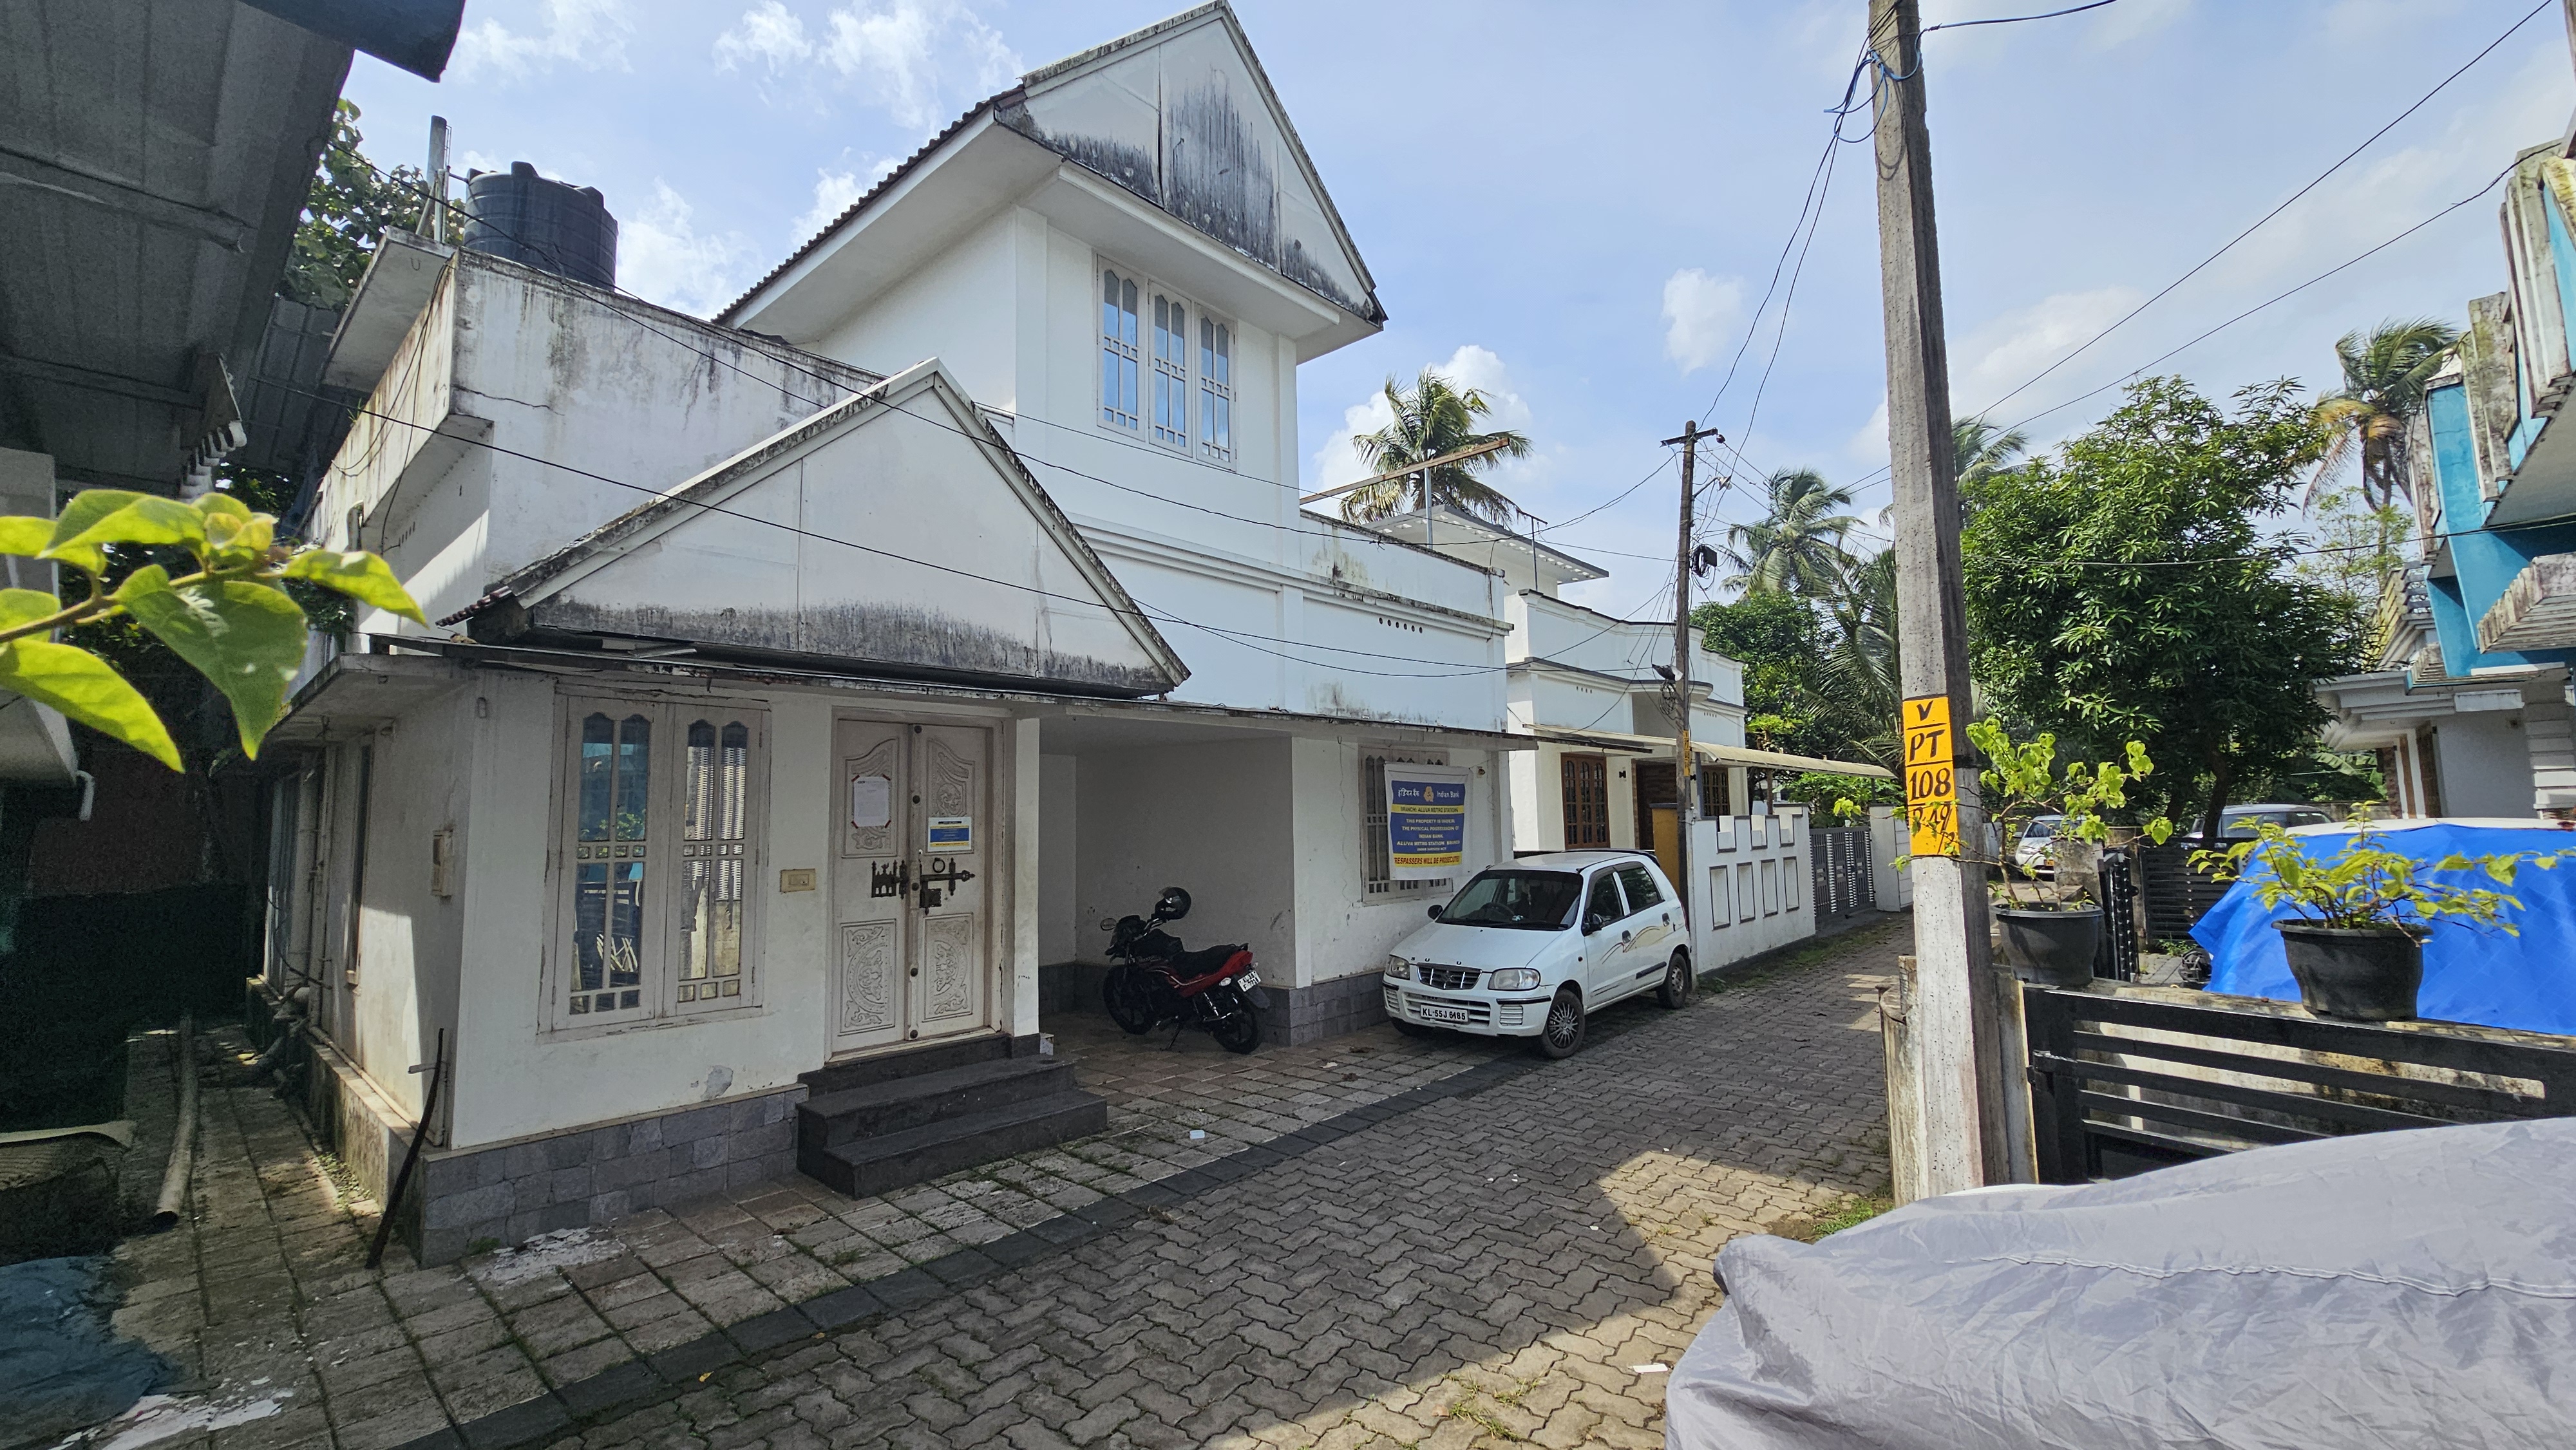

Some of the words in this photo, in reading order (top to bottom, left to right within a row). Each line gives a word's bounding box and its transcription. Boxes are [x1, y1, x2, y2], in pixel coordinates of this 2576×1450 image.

[1916, 700, 1934, 722] V
[1909, 729, 1946, 762] PT
[1909, 767, 1951, 802] 108
